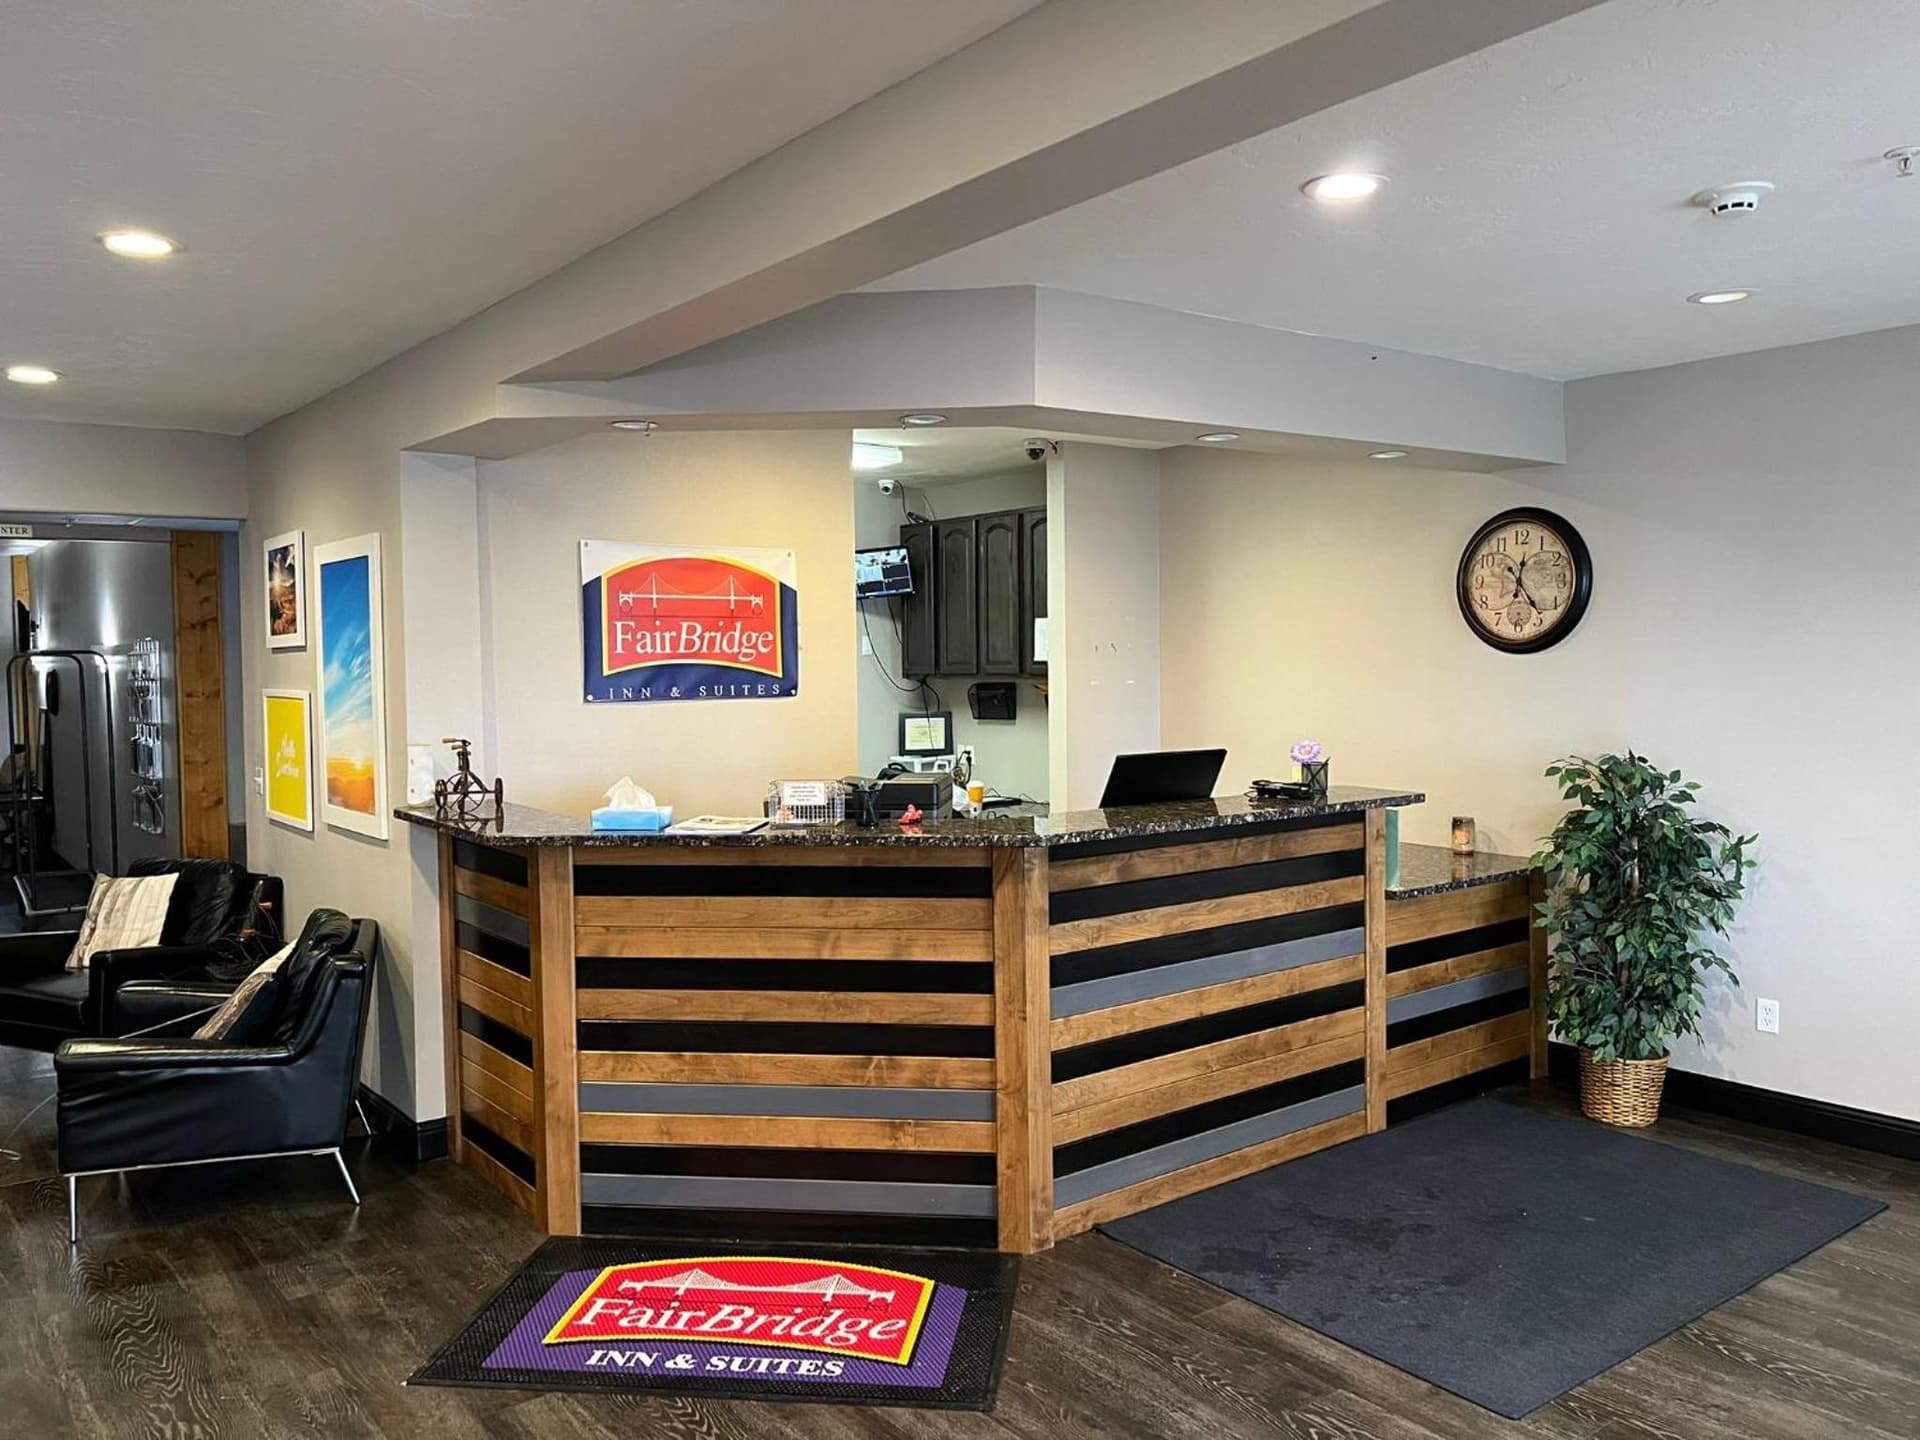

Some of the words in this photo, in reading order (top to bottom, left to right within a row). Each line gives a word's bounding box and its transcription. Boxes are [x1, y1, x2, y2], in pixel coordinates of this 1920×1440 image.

[1496, 537, 1507, 552] 11
[1514, 529, 1530, 545] 12
[1539, 535, 1545, 551] 1
[1480, 553, 1495, 569] 10
[1551, 551, 1562, 567] 2
[1475, 575, 1485, 590] 9
[1556, 573, 1567, 589] 3
[1479, 595, 1489, 610] 8
[1494, 612, 1502, 627] 7
[1514, 619, 1523, 633] 6
[1532, 611, 1544, 627] 5
[614, 620, 774, 662] FairBridge
[609, 687, 651, 700] INN
[670, 686, 681, 697] &
[699, 683, 780, 697] SUITES
[572, 1297, 907, 1346] FairBridge
[585, 1350, 662, 1367] INN
[664, 1353, 697, 1369] &
[705, 1355, 845, 1377] SUITES
